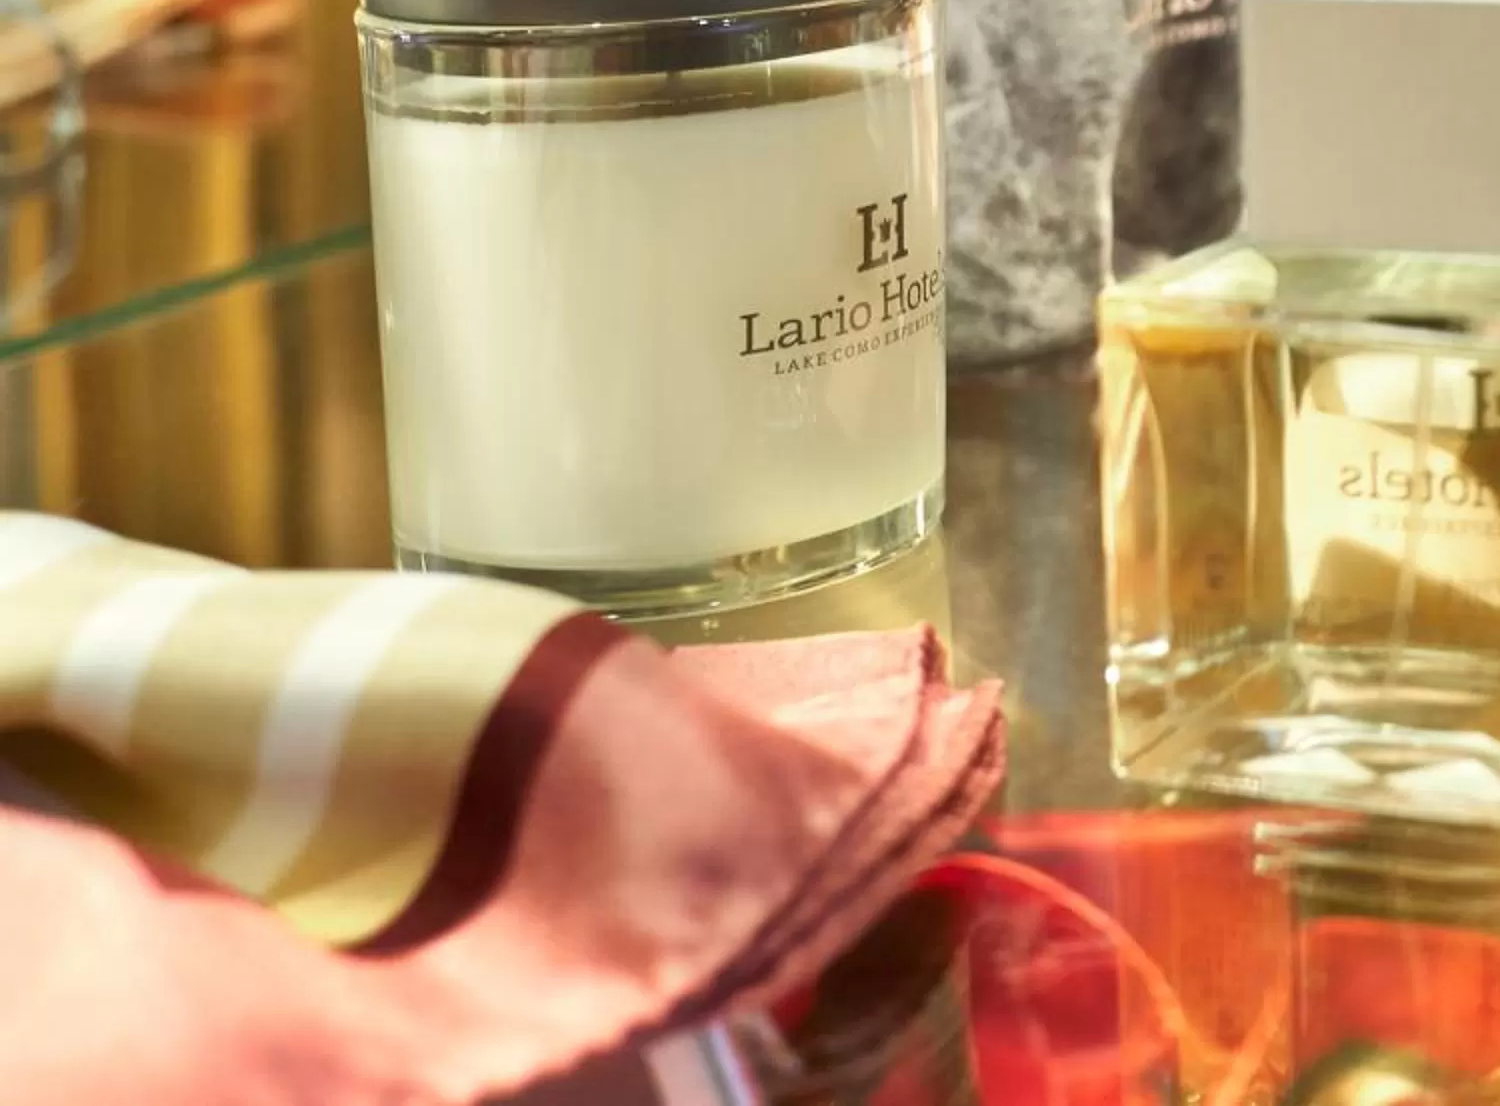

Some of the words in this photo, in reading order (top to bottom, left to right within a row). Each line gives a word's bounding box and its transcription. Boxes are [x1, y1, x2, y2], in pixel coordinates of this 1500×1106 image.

[739, 294, 872, 356] Lario
[773, 352, 829, 375] LAKE
[833, 336, 881, 363] COMO
